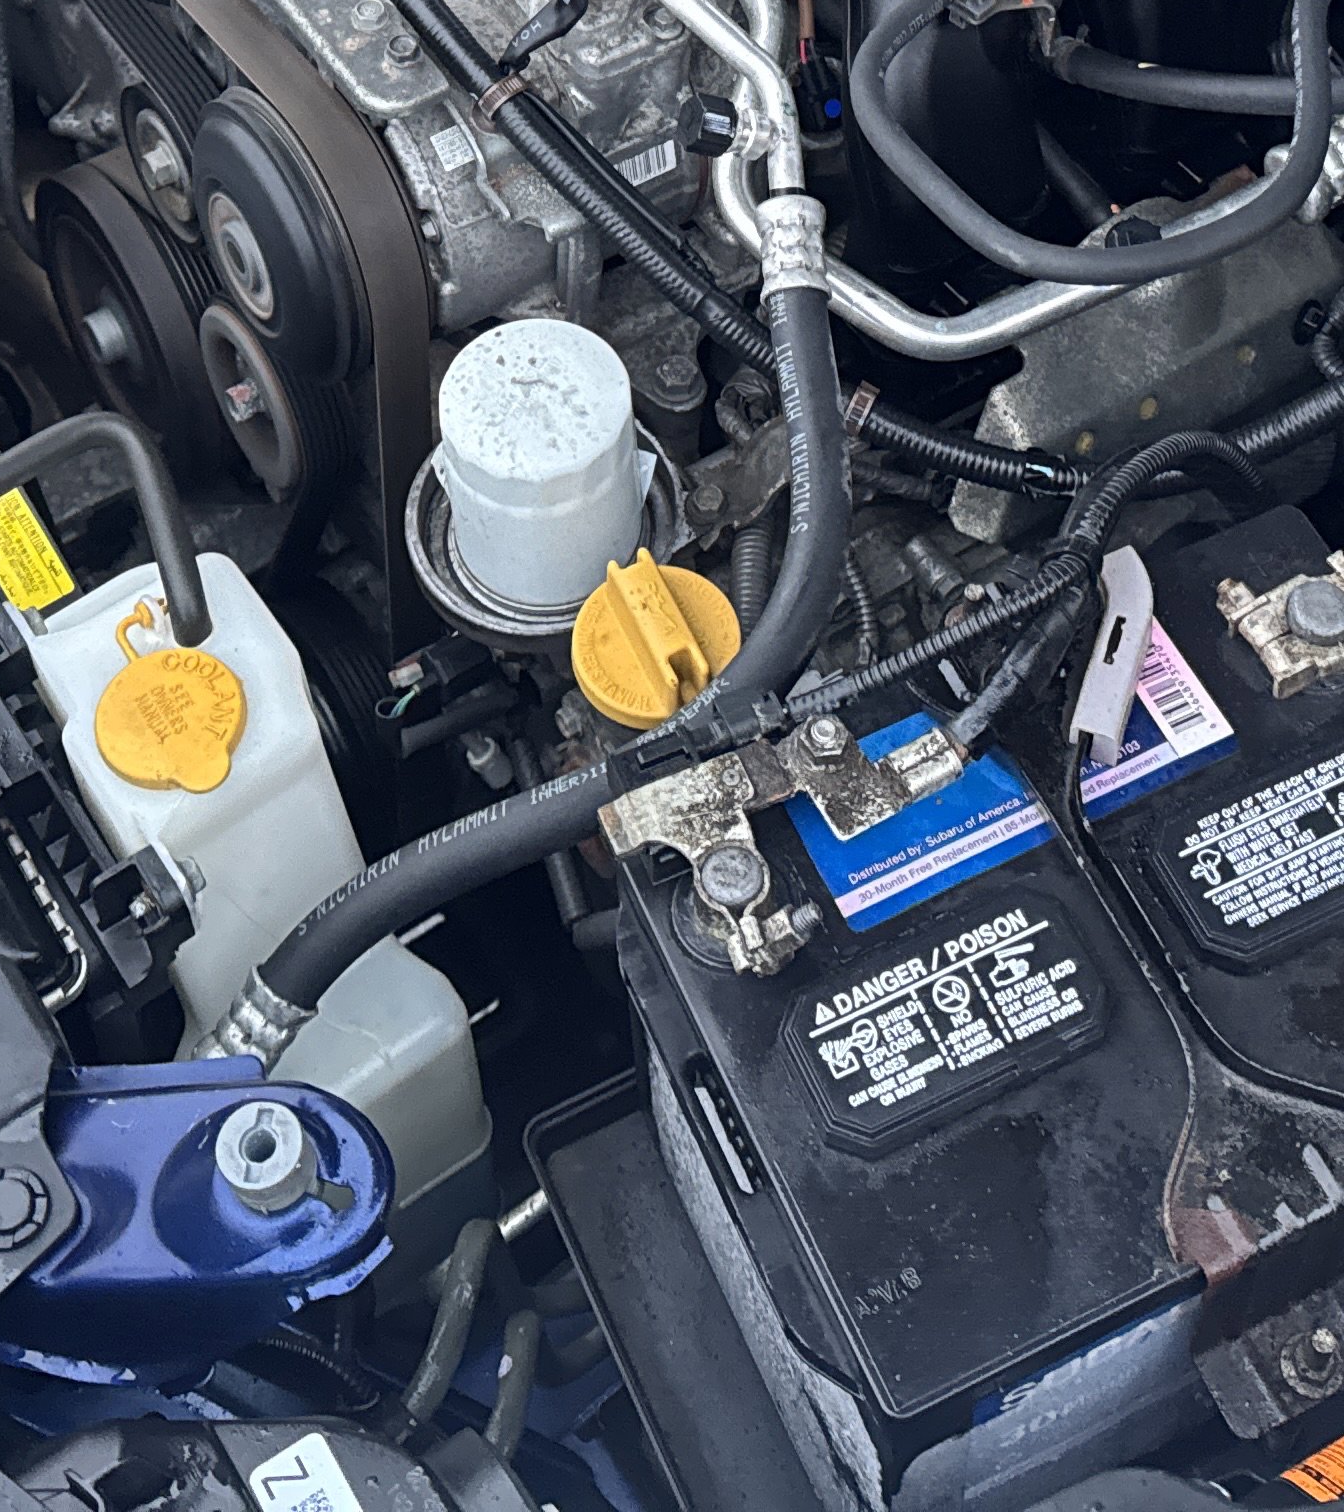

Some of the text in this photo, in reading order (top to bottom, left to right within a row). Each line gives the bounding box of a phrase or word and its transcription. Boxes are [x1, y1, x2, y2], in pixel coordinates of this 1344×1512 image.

[16, 511, 47, 555] ATTENTION
[160, 651, 235, 741] COOLANT
[169, 681, 195, 711] SEE
[133, 690, 174, 746] MANUAL
[1095, 751, 1160, 791] Replacement
[1184, 833, 1200, 847] DO
[1200, 823, 1222, 840] NOT
[1238, 804, 1263, 822] KEEP
[1262, 793, 1286, 811] VENT
[1285, 782, 1310, 800] CAPS
[1310, 769, 1338, 788] TIGHT
[1197, 811, 1221, 829] KEEP
[1221, 803, 1240, 818] OUT
[1240, 796, 1256, 809] OF
[1255, 787, 1274, 802] THE
[1273, 773, 1304, 794] REACH
[1303, 766, 1318, 780] OF
[1217, 795, 1324, 852] FLUSH EYES IMMEDIATELY
[1225, 844, 1249, 864] WITH
[1279, 821, 1299, 838] GET
[846, 848, 907, 885] Distributed
[906, 840, 926, 859] by:
[924, 821, 965, 848] Subaru
[963, 815, 977, 830] of
[857, 872, 909, 904] 30-Month
[907, 860, 933, 879] Free
[932, 828, 1000, 868] Replacement
[1232, 828, 1316, 875] MEDICAL HELP FAST
[1247, 873, 1266, 889] FOR
[1265, 863, 1287, 881] SAFE
[1285, 853, 1309, 871] JUMP
[1220, 892, 1253, 914] FOLLOW
[1252, 866, 1309, 899] INSTRUCTIONS
[1308, 861, 1319, 873] IN
[1301, 873, 1320, 889] NOT
[1245, 909, 1269, 927] SEEK
[1267, 894, 1301, 917] SERVICE
[831, 907, 1028, 1015] DANGER / POISON
[994, 958, 1077, 1007] SULFURIC ACID
[1001, 984, 1056, 1017] CAN CAUSE
[875, 999, 919, 1029] SHIELD
[950, 1008, 972, 1028] NO
[1007, 987, 1078, 1028] BLINDNESS OR
[1013, 999, 1083, 1039] SEVERE BURNS
[862, 1029, 925, 1068] EXPLOSIVE
[882, 1017, 914, 1042] EYES
[848, 1054, 944, 1107] CAN CAUSE BLINDNESS
[869, 1053, 909, 1081] GASES
[879, 1076, 927, 1107] OR INJURY
